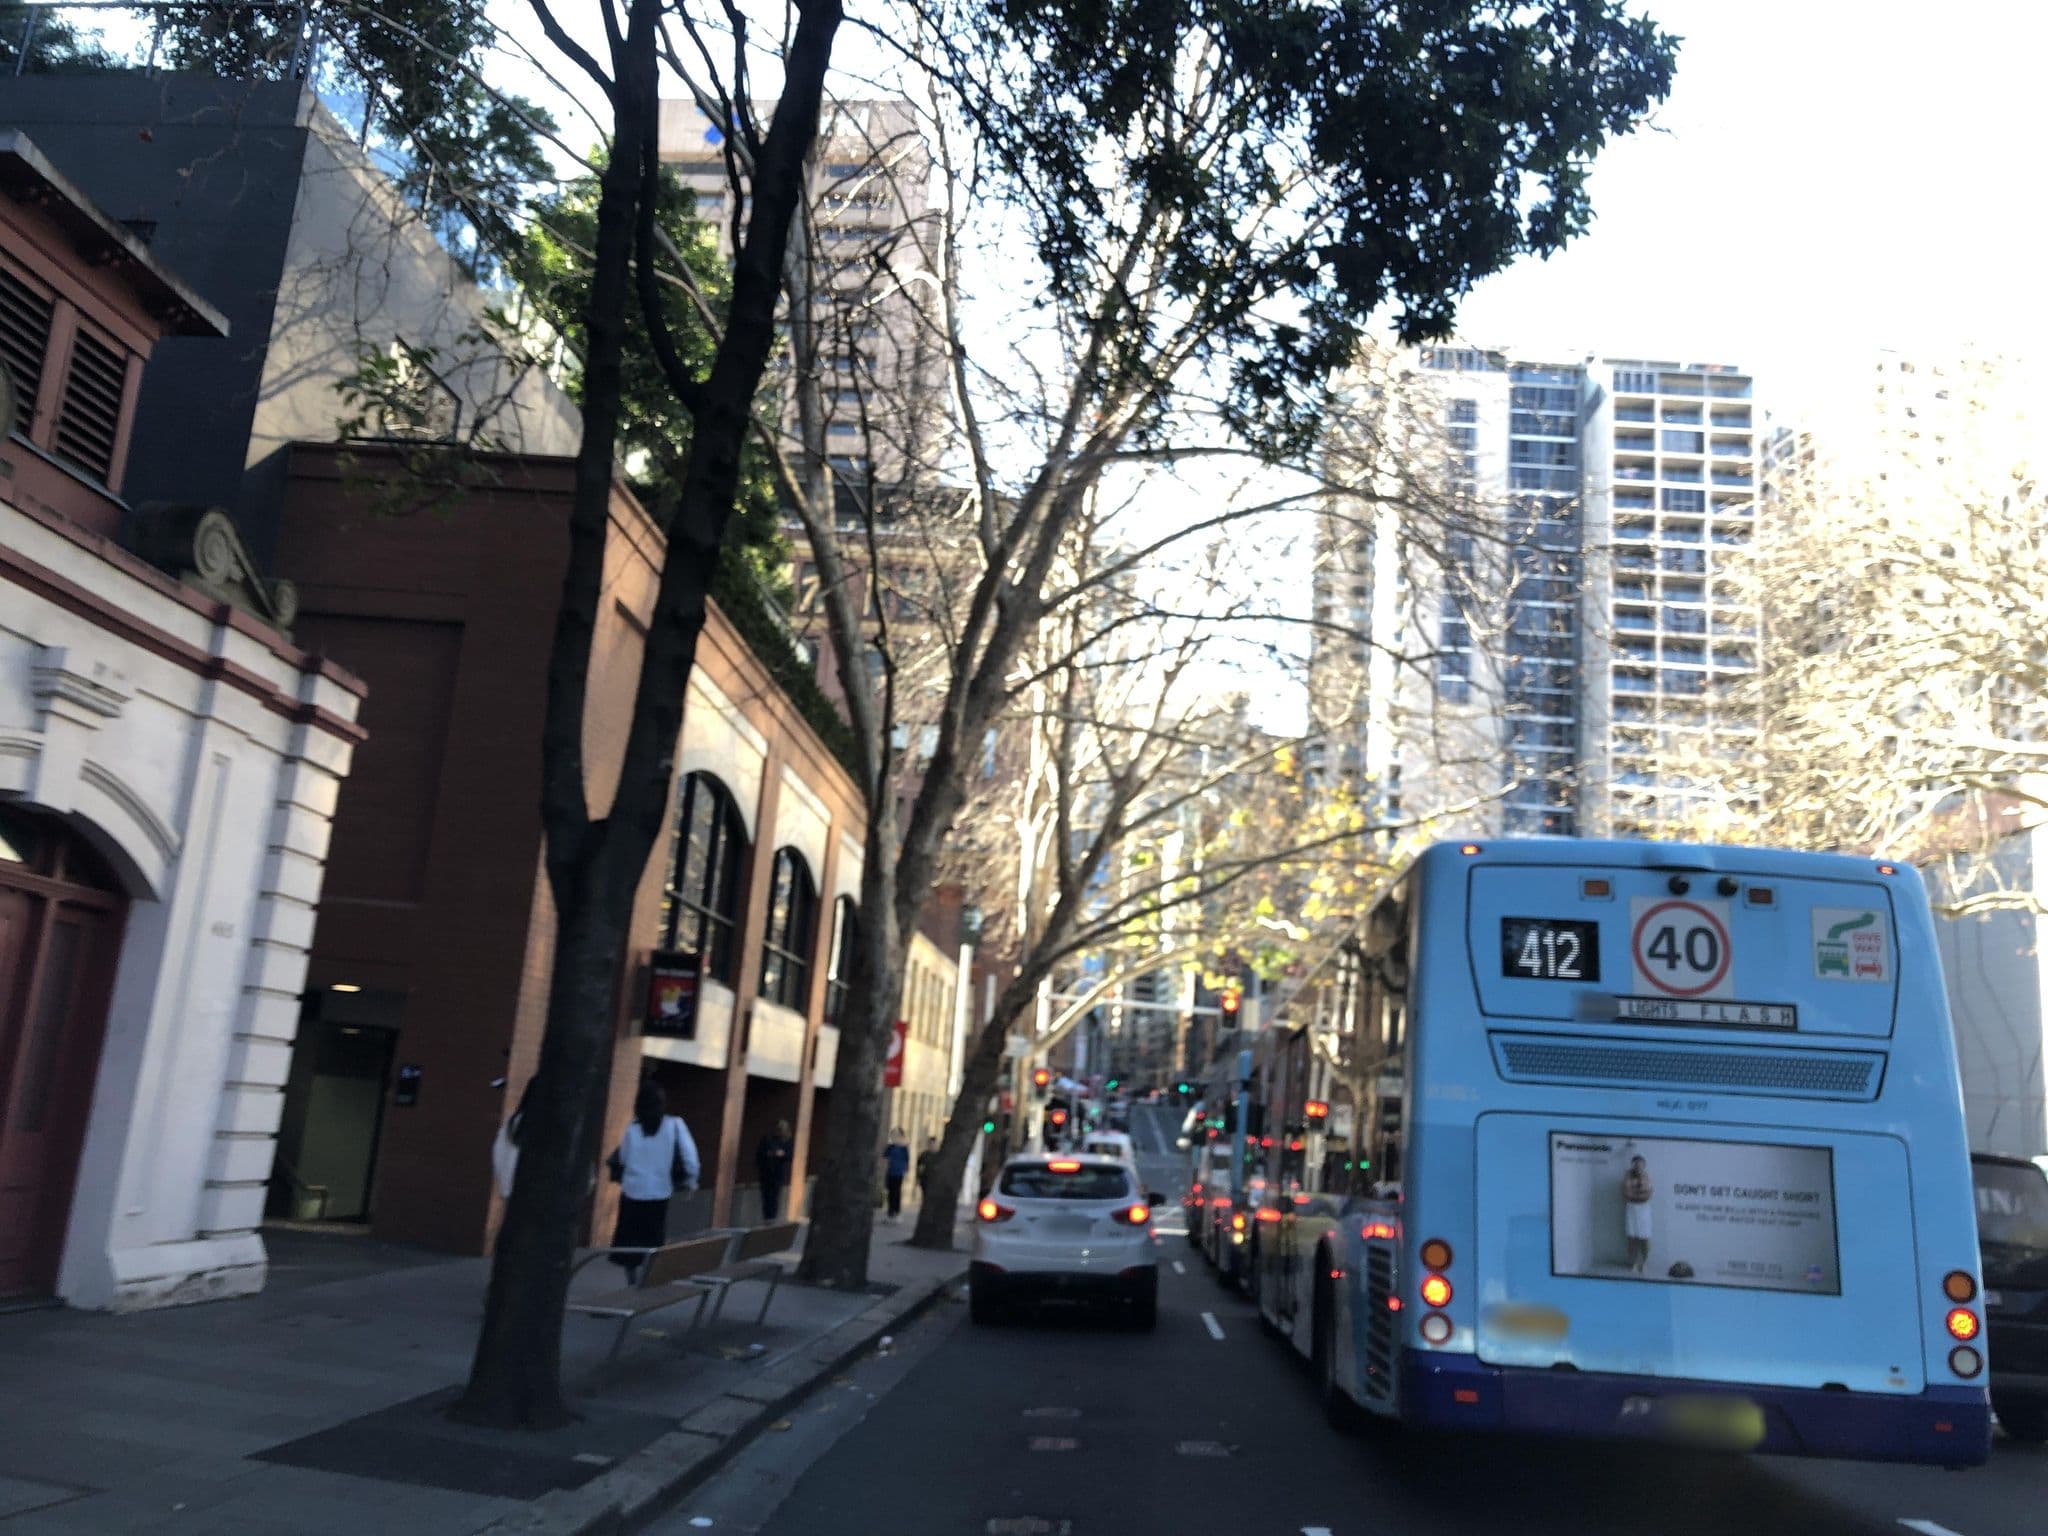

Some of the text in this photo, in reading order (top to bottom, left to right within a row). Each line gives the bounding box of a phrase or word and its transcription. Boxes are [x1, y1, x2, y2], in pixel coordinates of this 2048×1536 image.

[1518, 929, 1582, 978] 412
[1647, 926, 1718, 972] 40
[1628, 1000, 1679, 1018] LIGHTS
